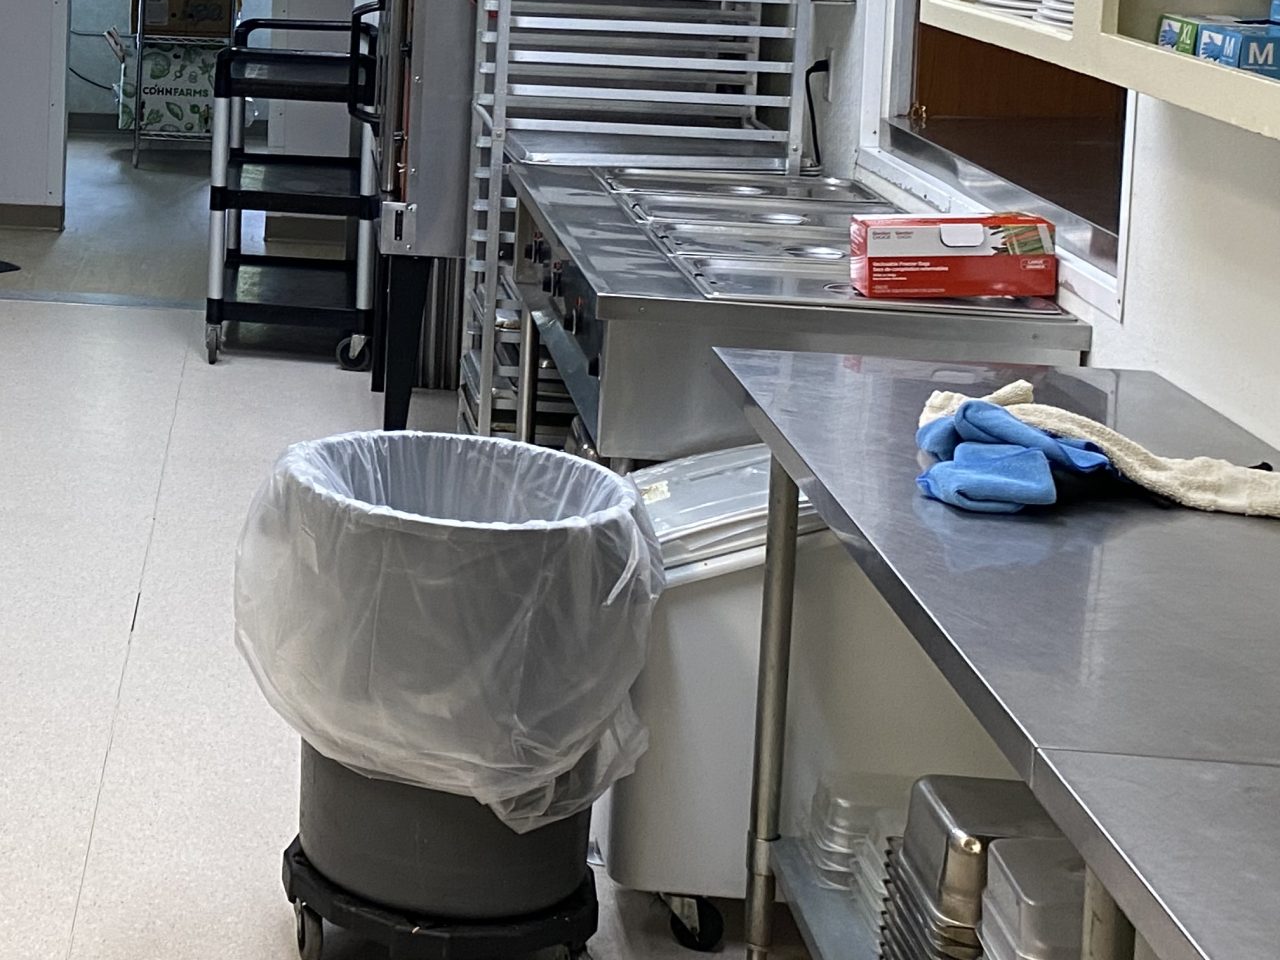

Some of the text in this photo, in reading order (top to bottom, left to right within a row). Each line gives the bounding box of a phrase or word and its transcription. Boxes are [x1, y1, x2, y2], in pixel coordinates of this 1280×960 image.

[1180, 23, 1192, 44] XL
[1223, 36, 1236, 57] M
[1248, 42, 1274, 65] M
